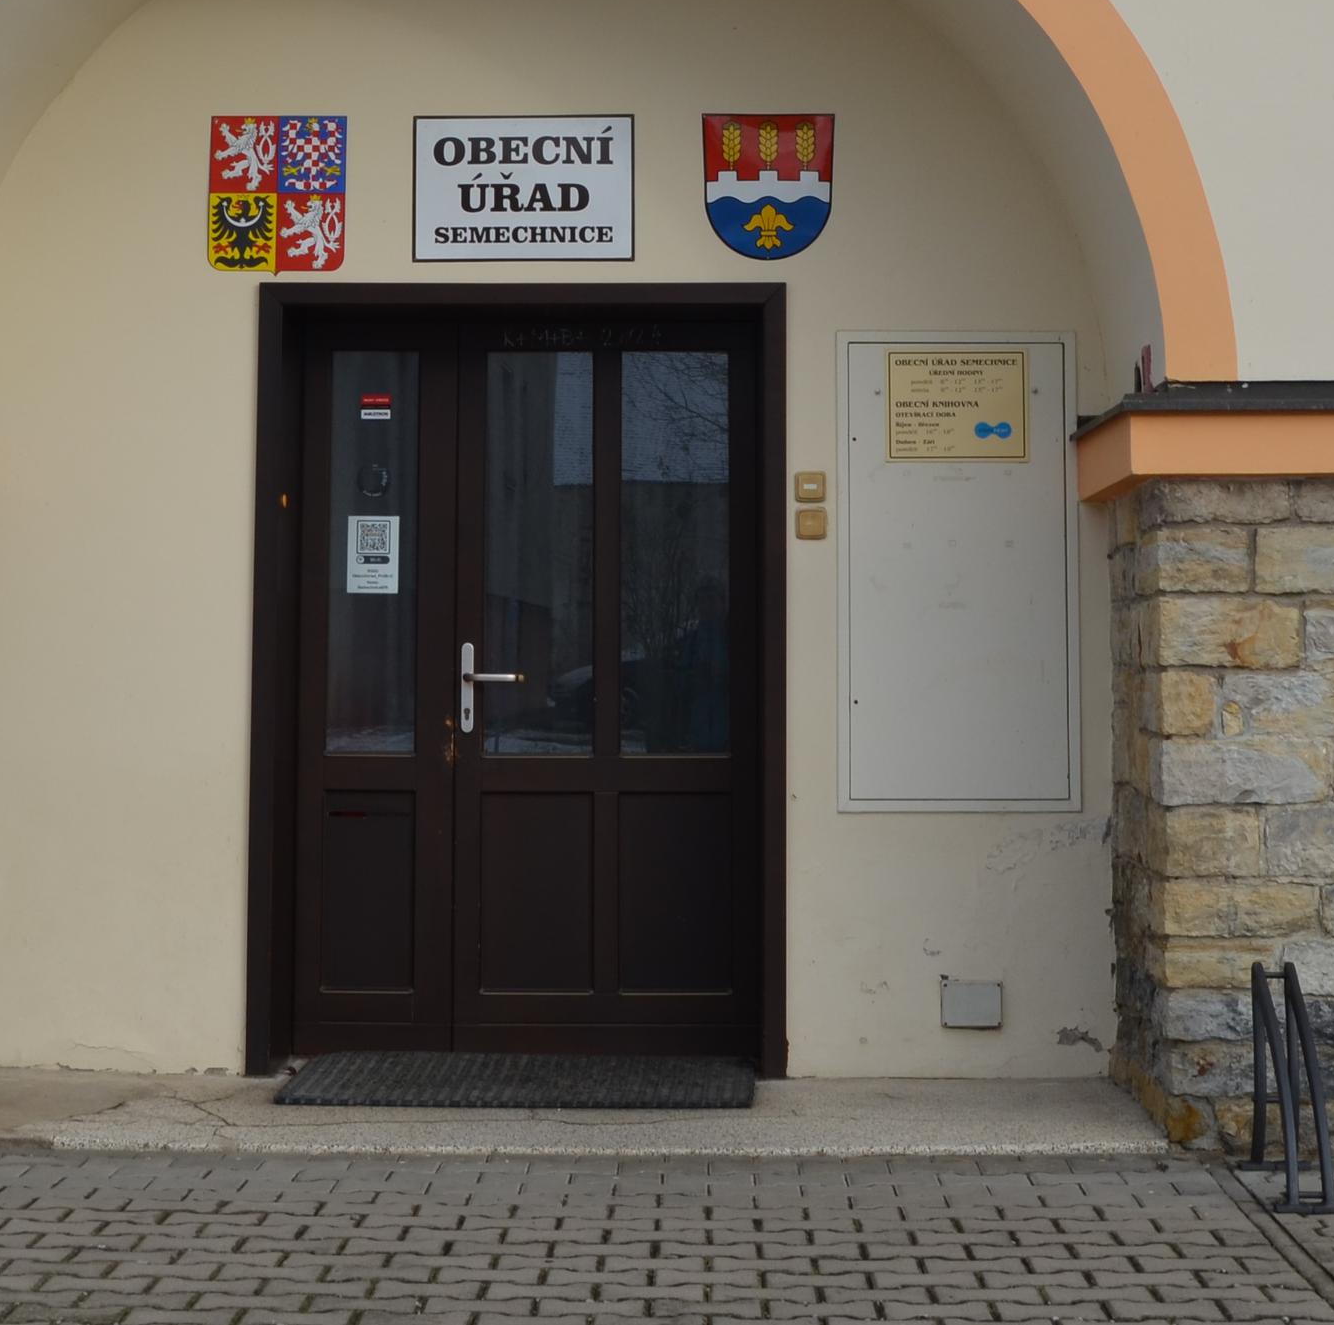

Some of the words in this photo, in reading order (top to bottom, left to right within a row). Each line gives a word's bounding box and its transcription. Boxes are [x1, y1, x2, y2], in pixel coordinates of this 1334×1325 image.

[433, 125, 613, 166] OBECNÍ
[457, 171, 590, 213] ÚŘAD
[434, 226, 613, 244] SEMECHNICE
[895, 358, 928, 366] OBECNÍ
[932, 358, 957, 366] ÚŘAD
[960, 358, 1018, 366] SEMECHNICE
[895, 400, 929, 408] OBECNÍ
[932, 400, 979, 408] KNIHOVNA
